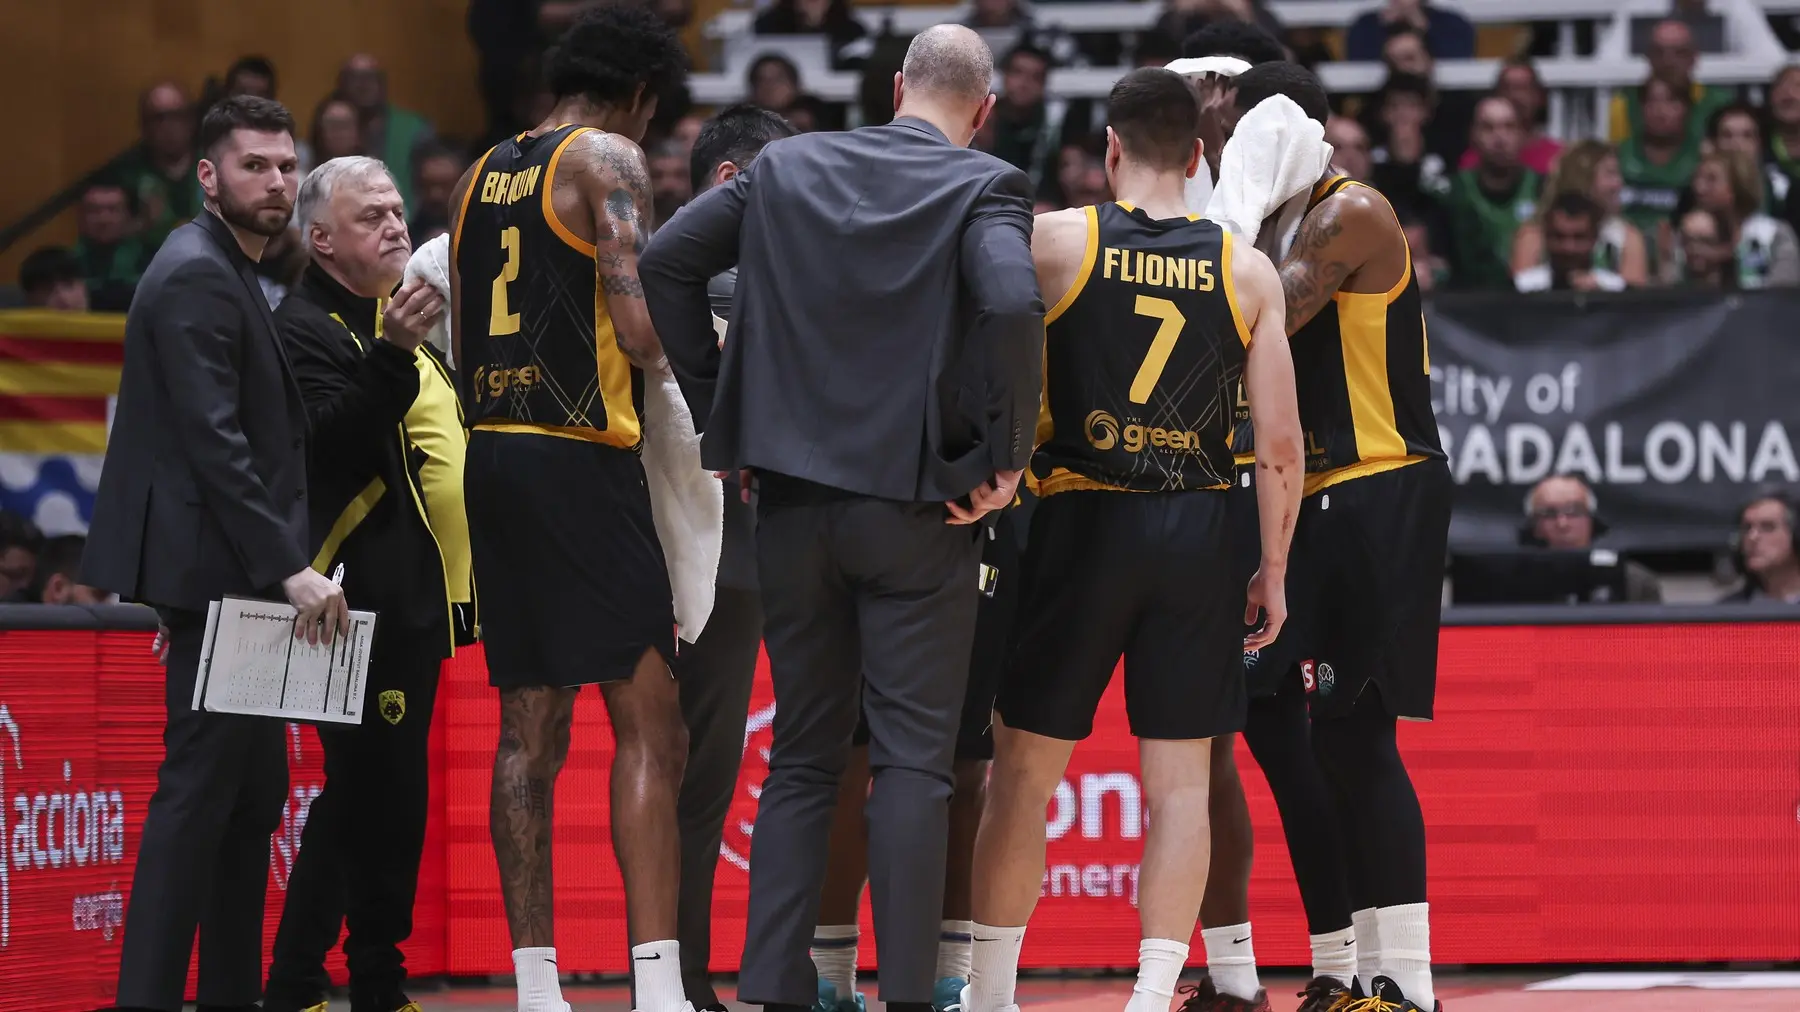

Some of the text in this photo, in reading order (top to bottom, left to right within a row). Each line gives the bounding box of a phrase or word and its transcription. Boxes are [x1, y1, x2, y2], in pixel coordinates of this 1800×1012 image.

[489, 226, 520, 336] 2
[1103, 247, 1215, 292] FLIONIS
[1129, 294, 1187, 405] 7
[1525, 361, 1581, 414] of
[1123, 424, 1200, 453] green
[11, 760, 124, 870] acciona
